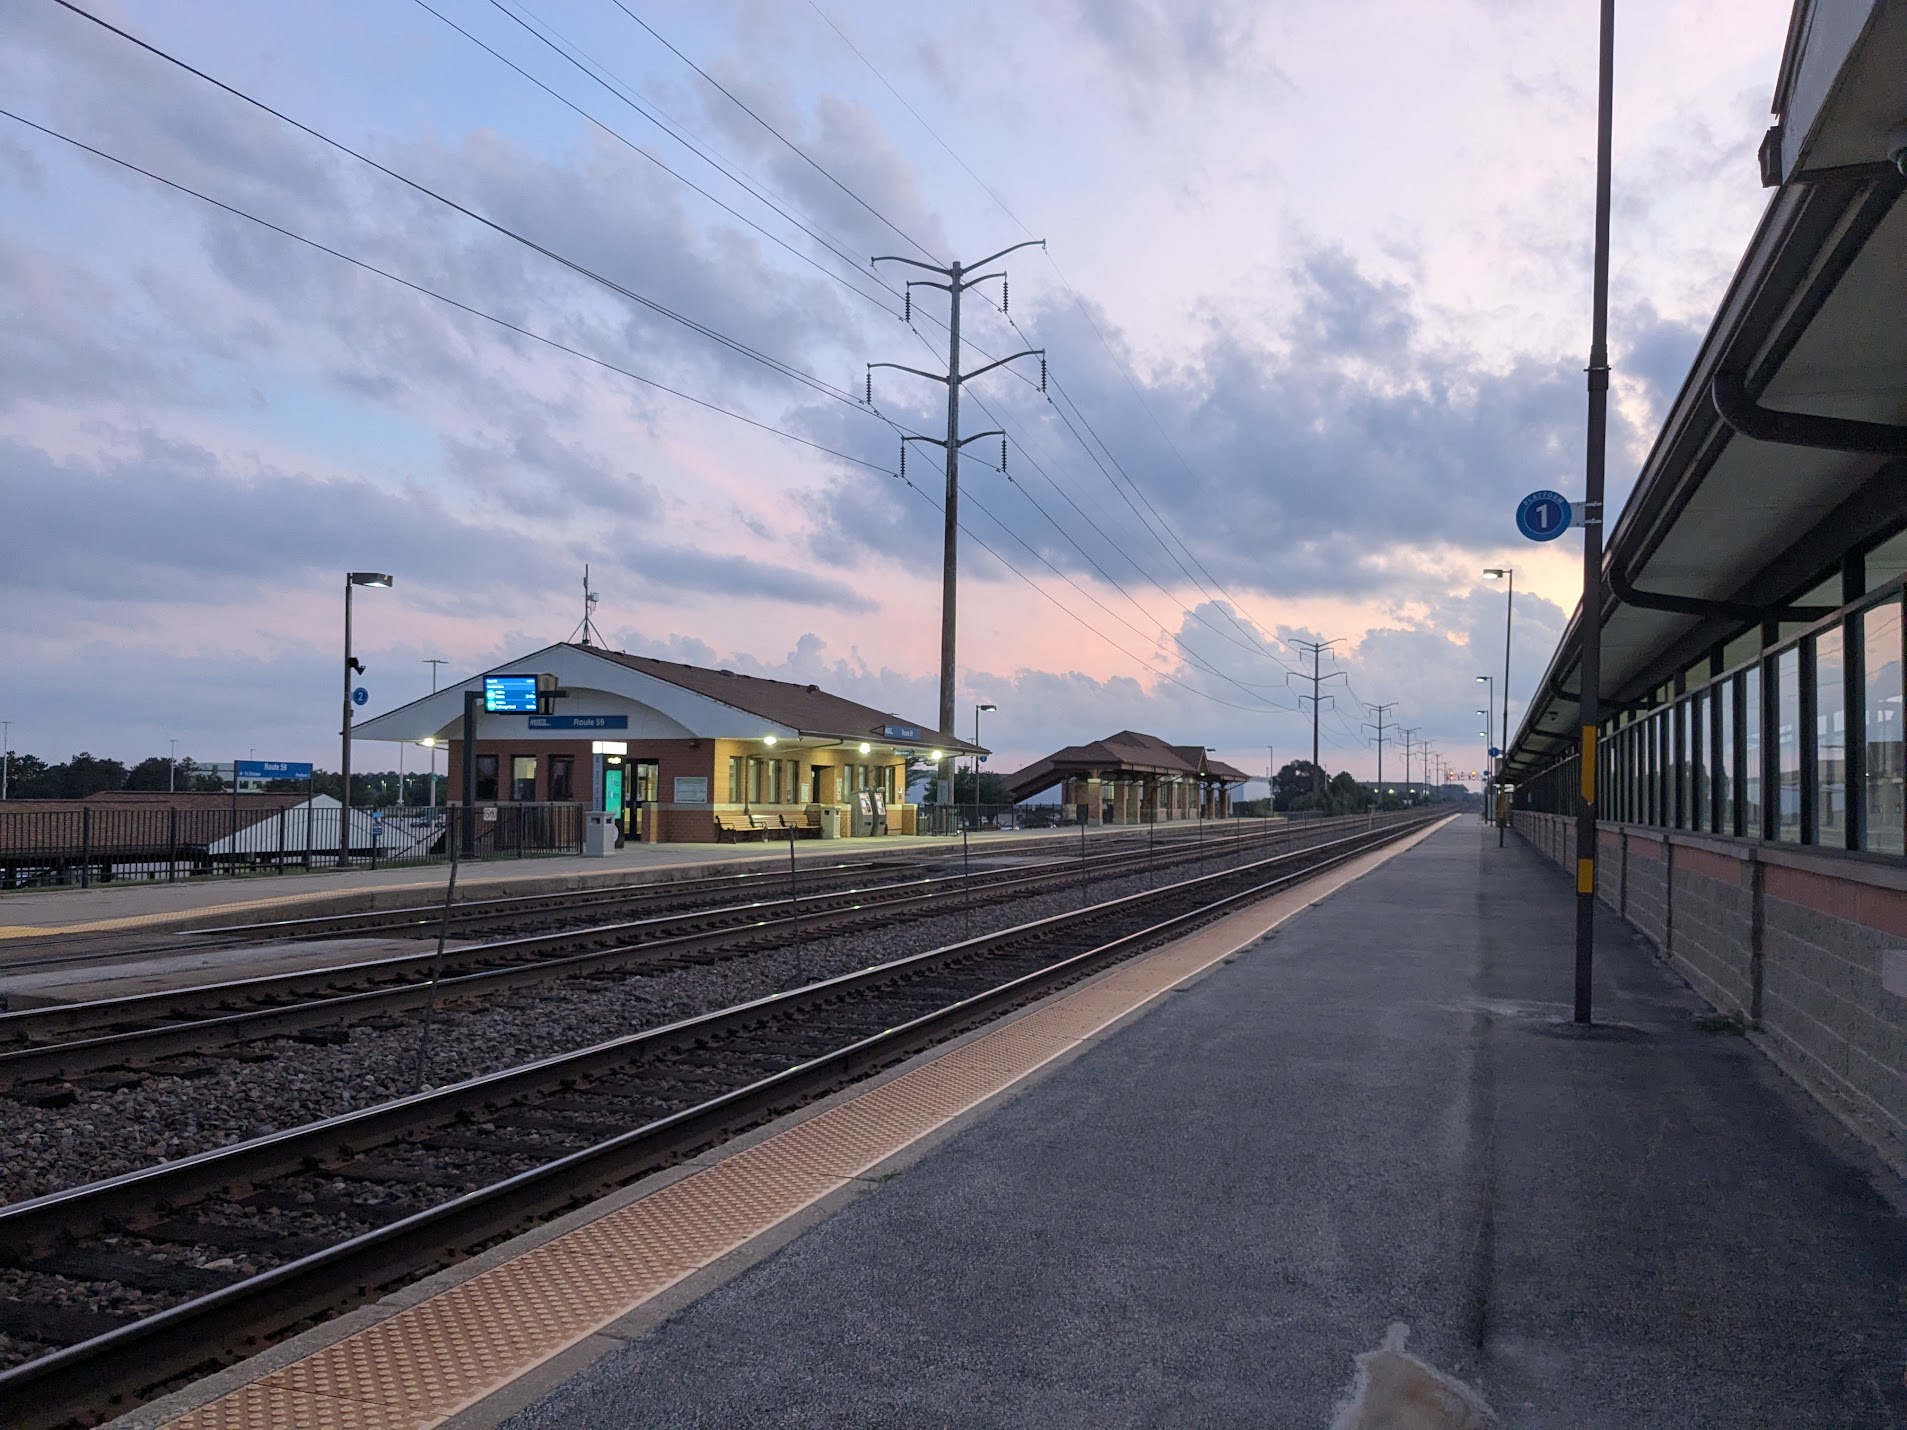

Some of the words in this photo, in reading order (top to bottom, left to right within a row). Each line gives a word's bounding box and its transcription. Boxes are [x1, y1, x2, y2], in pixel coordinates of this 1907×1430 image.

[1523, 492, 1565, 506] PLATFORM
[1536, 504, 1548, 529] 1
[357, 691, 364, 701] 2
[573, 718, 595, 726] Route
[595, 718, 605, 726] 59
[264, 762, 280, 771] Route
[280, 763, 288, 771] 59
